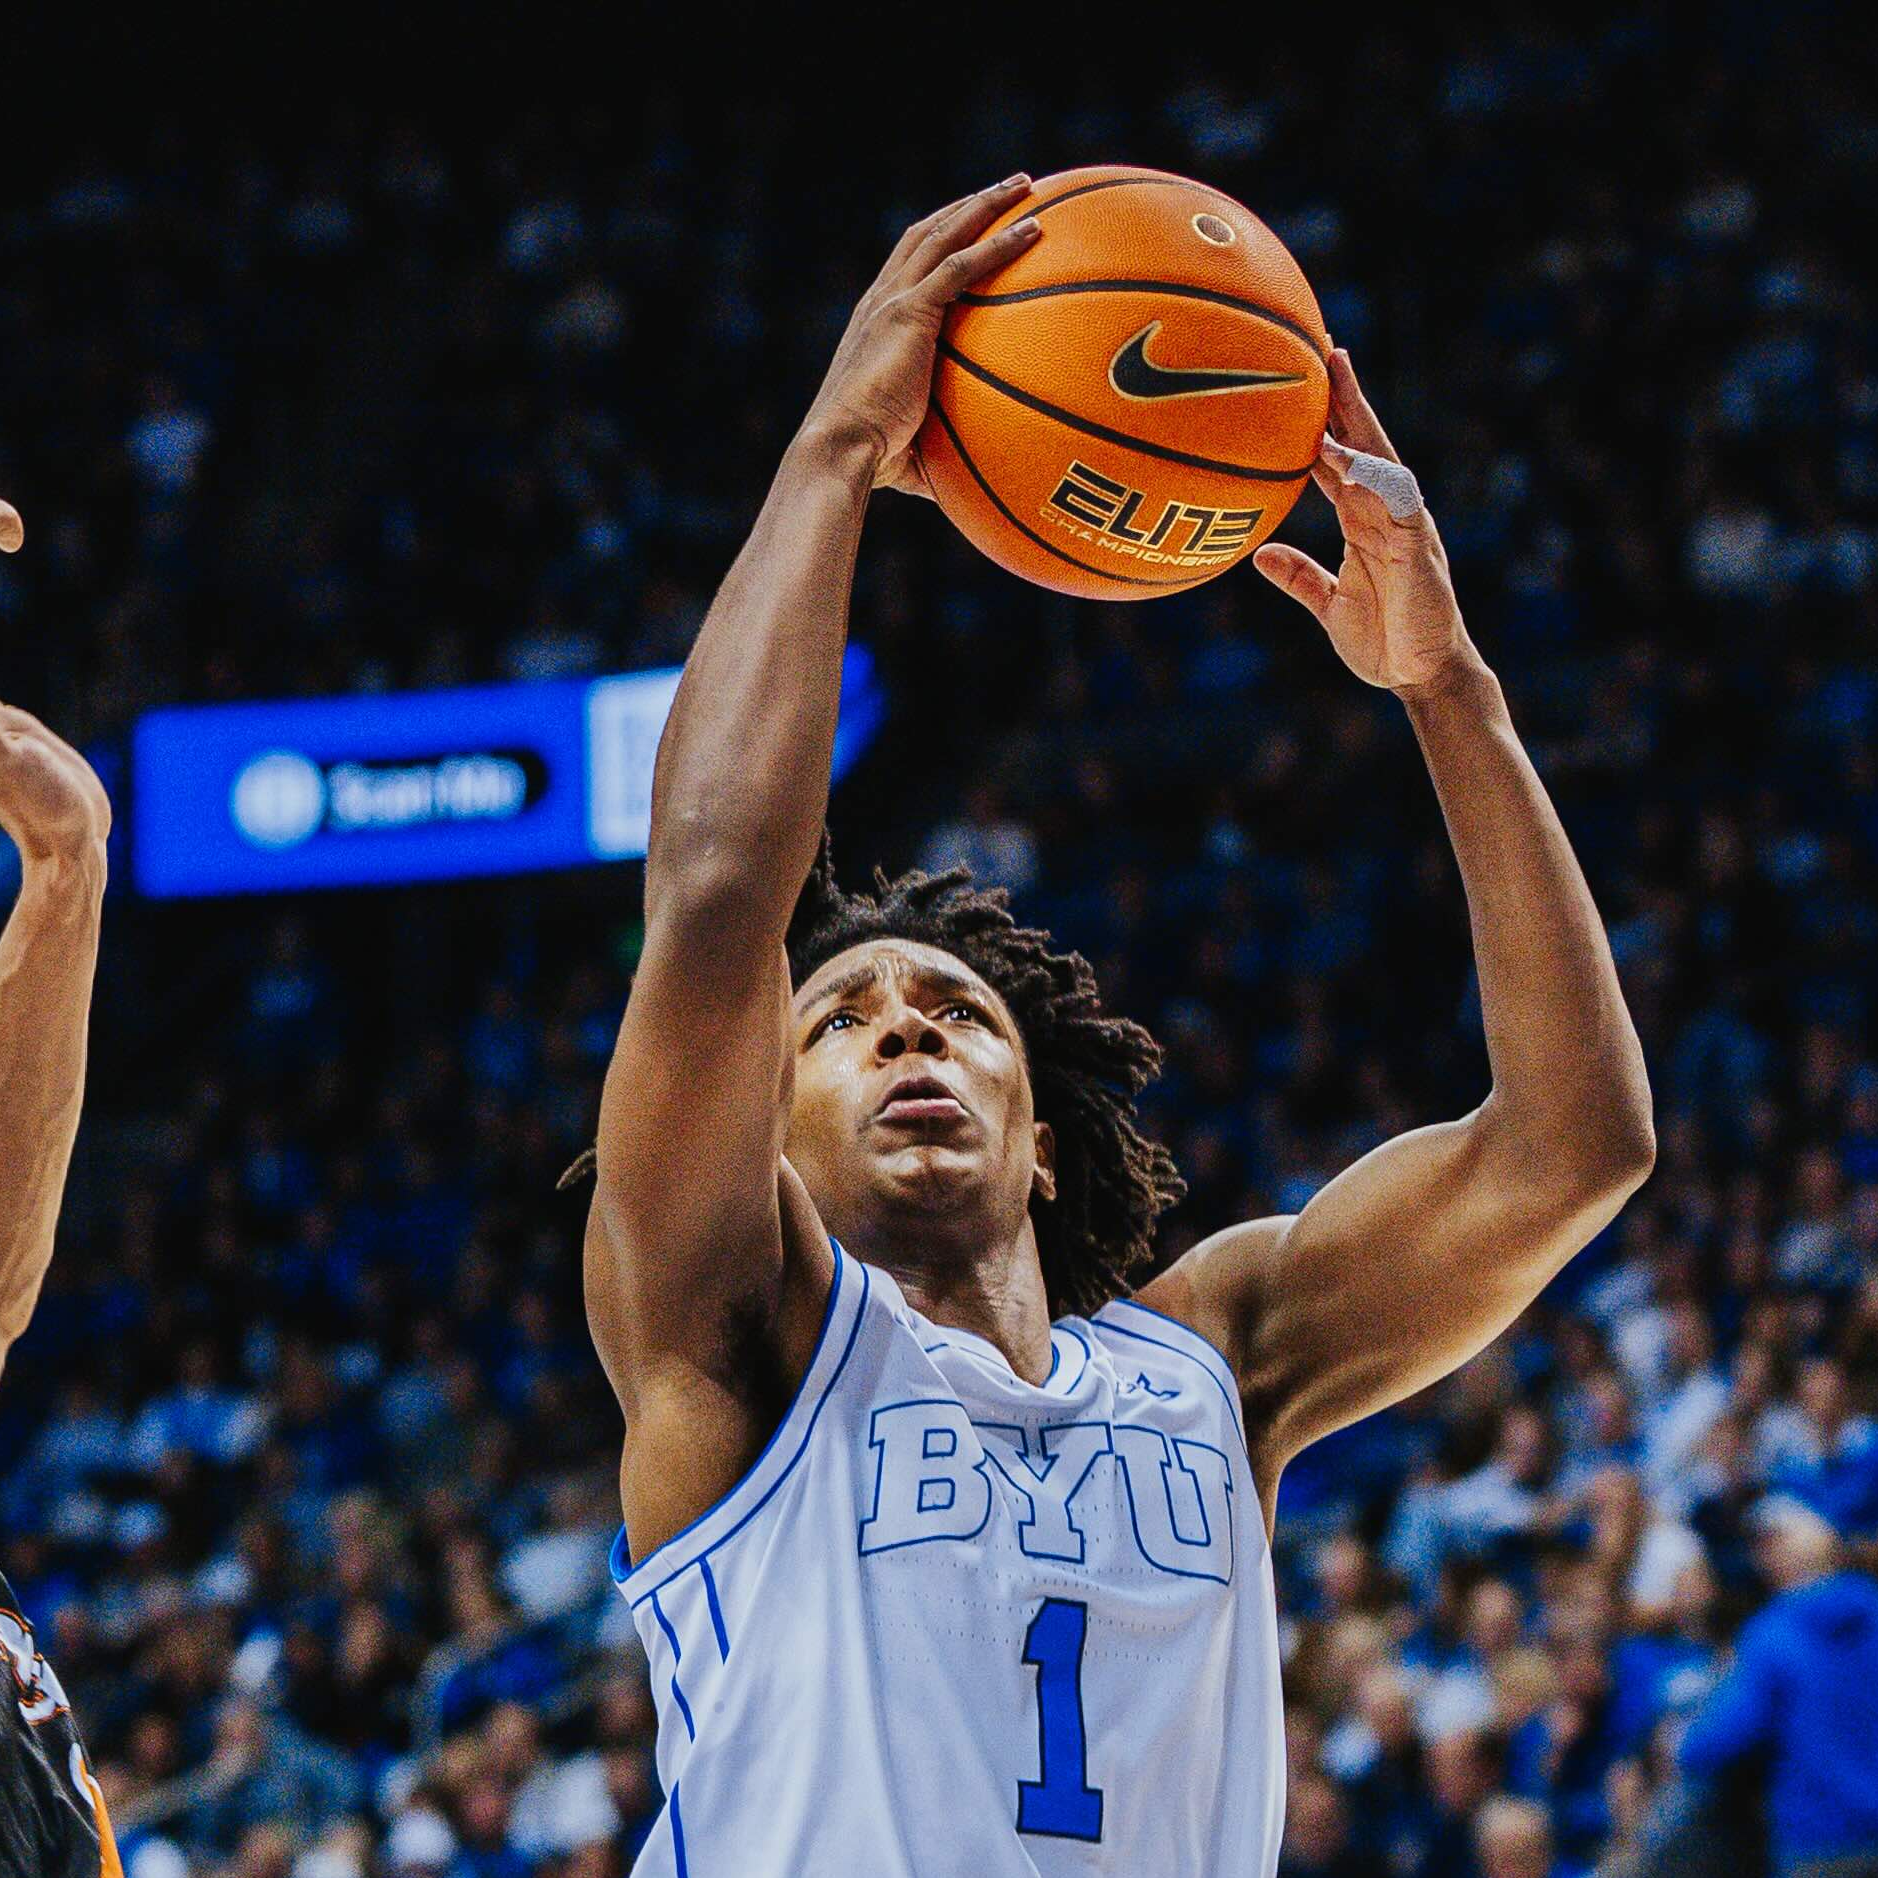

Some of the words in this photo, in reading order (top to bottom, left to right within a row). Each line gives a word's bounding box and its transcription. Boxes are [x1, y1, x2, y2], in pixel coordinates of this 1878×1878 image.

[1049, 459, 1264, 556] ELITE
[859, 1399, 1234, 1586] BYU
[1017, 1598, 1103, 1844] 1
